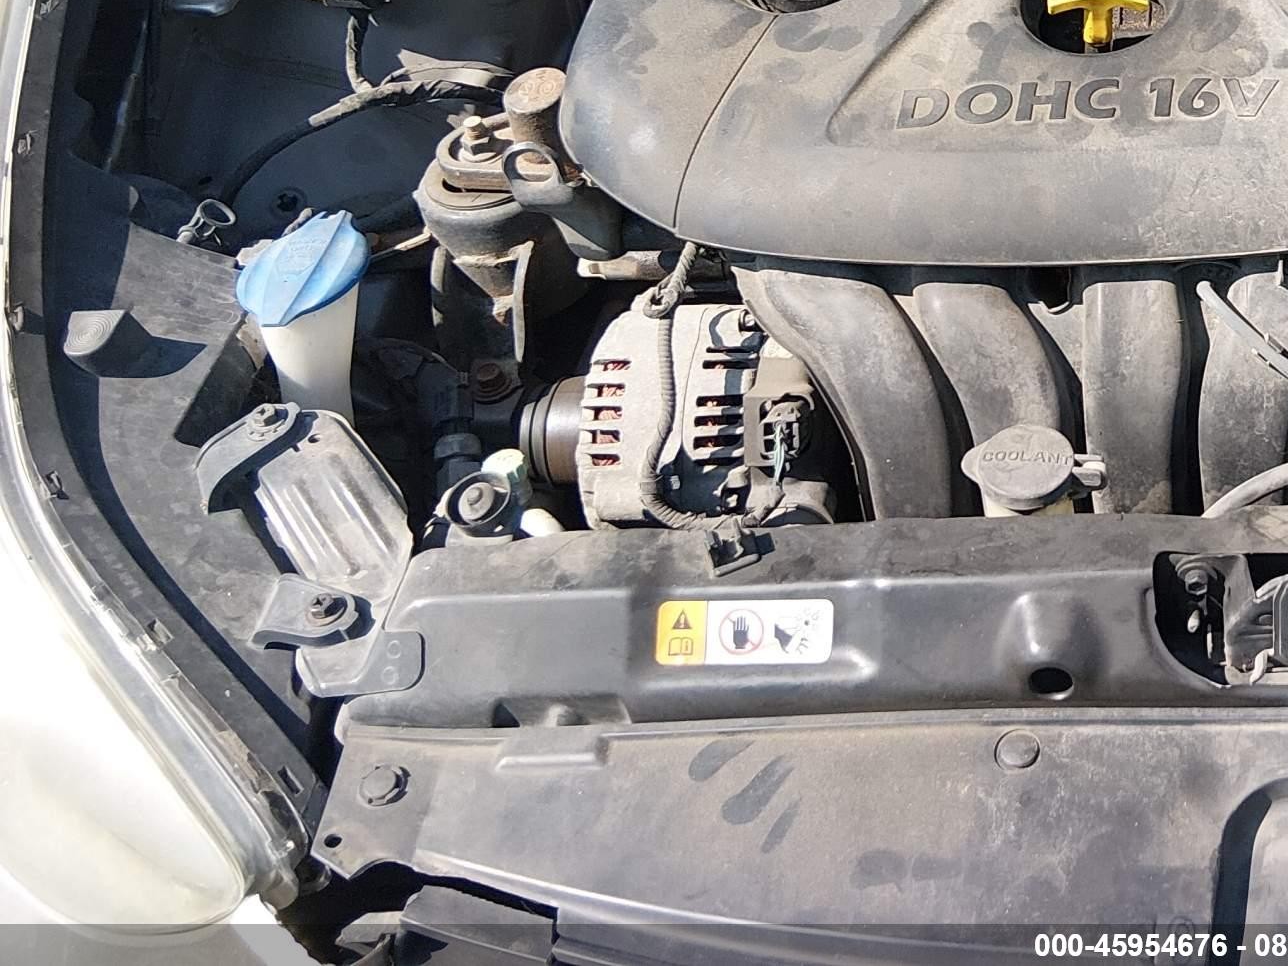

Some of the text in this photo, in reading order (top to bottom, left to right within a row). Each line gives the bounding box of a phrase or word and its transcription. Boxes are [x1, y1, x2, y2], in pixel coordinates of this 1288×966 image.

[896, 77, 1280, 129] DOHC 16V
[982, 449, 1073, 466] COOLANT
